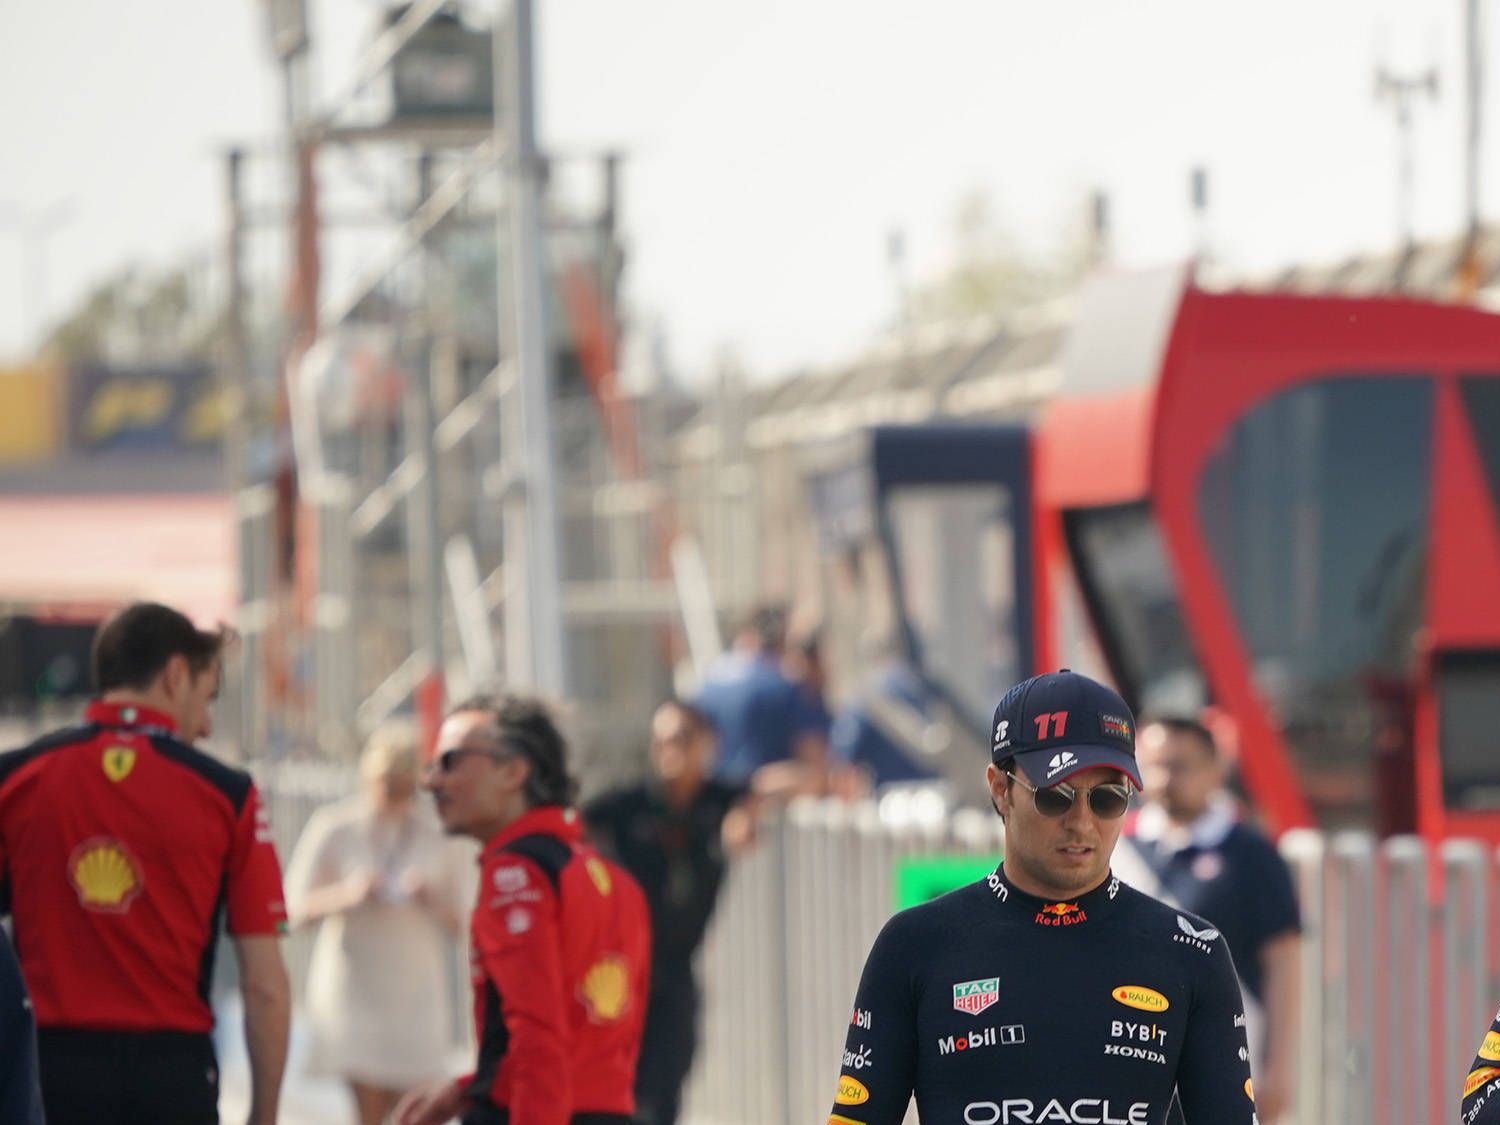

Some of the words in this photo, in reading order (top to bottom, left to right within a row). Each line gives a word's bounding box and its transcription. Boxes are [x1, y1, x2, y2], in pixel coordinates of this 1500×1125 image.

[1033, 711, 1069, 741] 11
[1035, 912, 1061, 927] Red
[1062, 911, 1088, 927] Bull
[956, 981, 996, 996] TAG
[955, 993, 997, 1011] HEUER
[1127, 990, 1164, 1007] RAUCH
[937, 1027, 997, 1056] Mobil
[1111, 1020, 1168, 1046] BYBIT
[1103, 1044, 1167, 1064] HONDA
